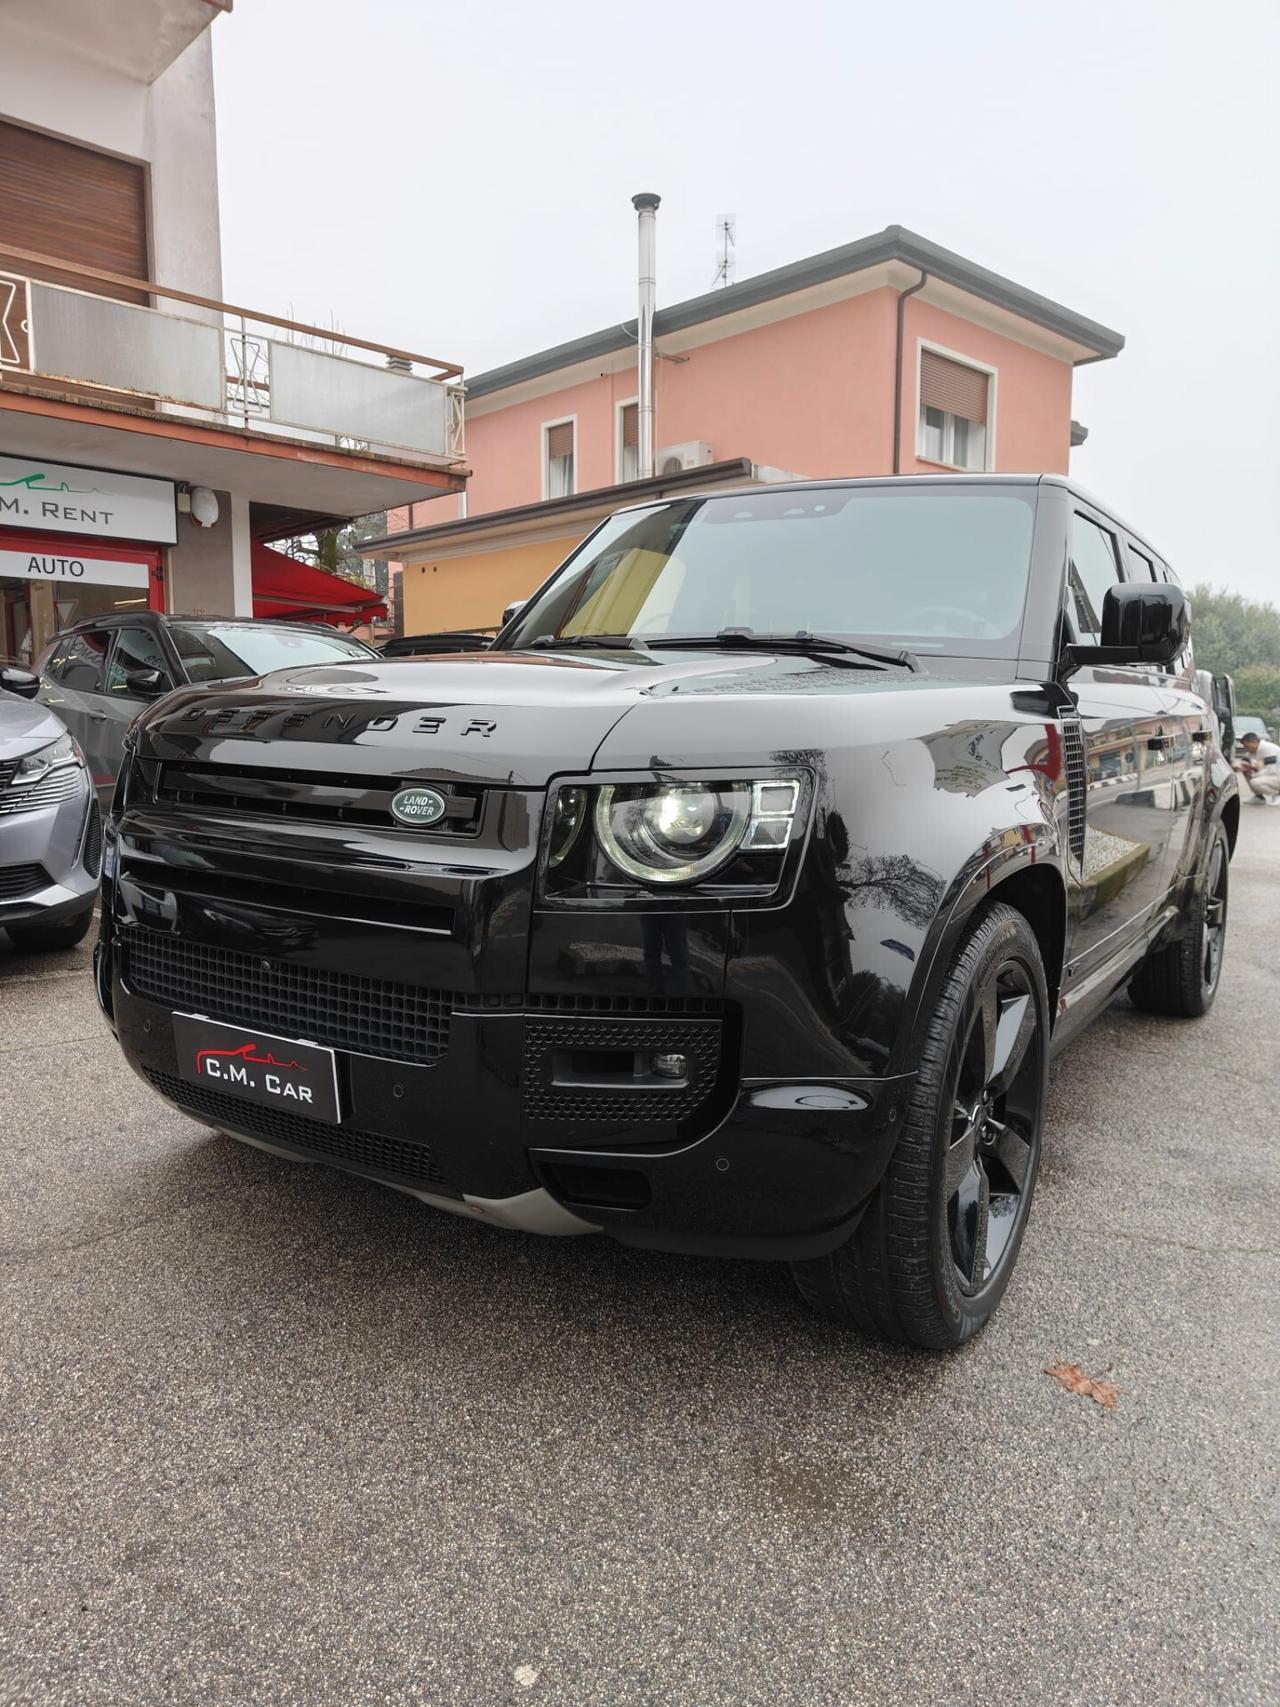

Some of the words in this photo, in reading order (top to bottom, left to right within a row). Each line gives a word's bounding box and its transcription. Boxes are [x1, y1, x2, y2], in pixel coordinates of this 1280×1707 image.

[42, 501, 114, 525] RENT
[27, 556, 85, 577] AUTO
[181, 708, 498, 737] DEFENDER
[206, 1058, 256, 1088] C.M.
[265, 1074, 314, 1104] CAR
